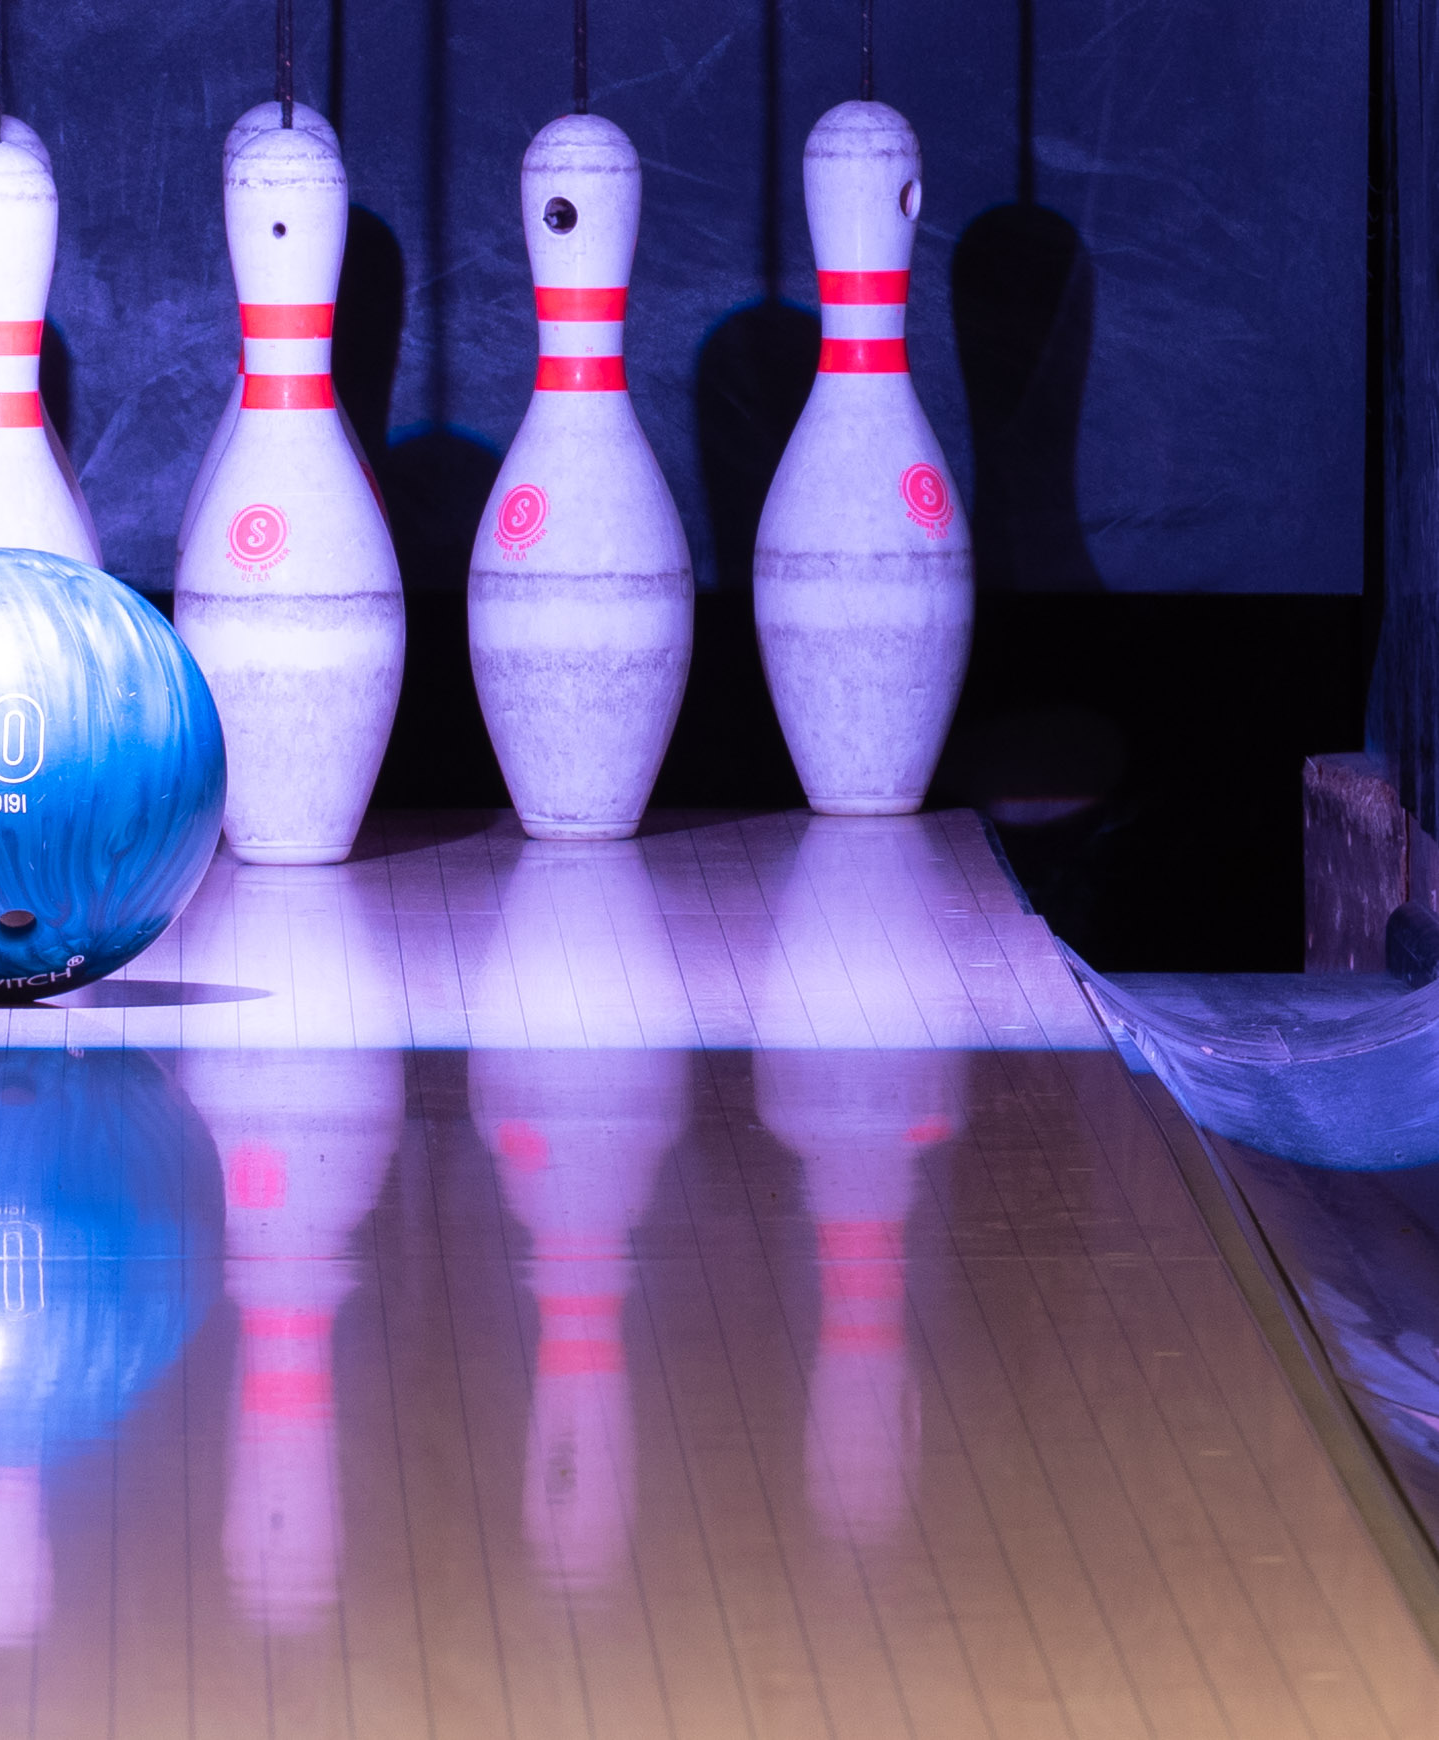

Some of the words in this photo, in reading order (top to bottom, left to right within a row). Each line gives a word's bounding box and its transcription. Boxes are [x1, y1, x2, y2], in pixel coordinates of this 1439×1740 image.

[922, 476, 937, 506] S
[511, 498, 530, 528] S
[247, 517, 267, 548] S
[259, 547, 291, 571] MAKER
[241, 572, 271, 583] ULTRA
